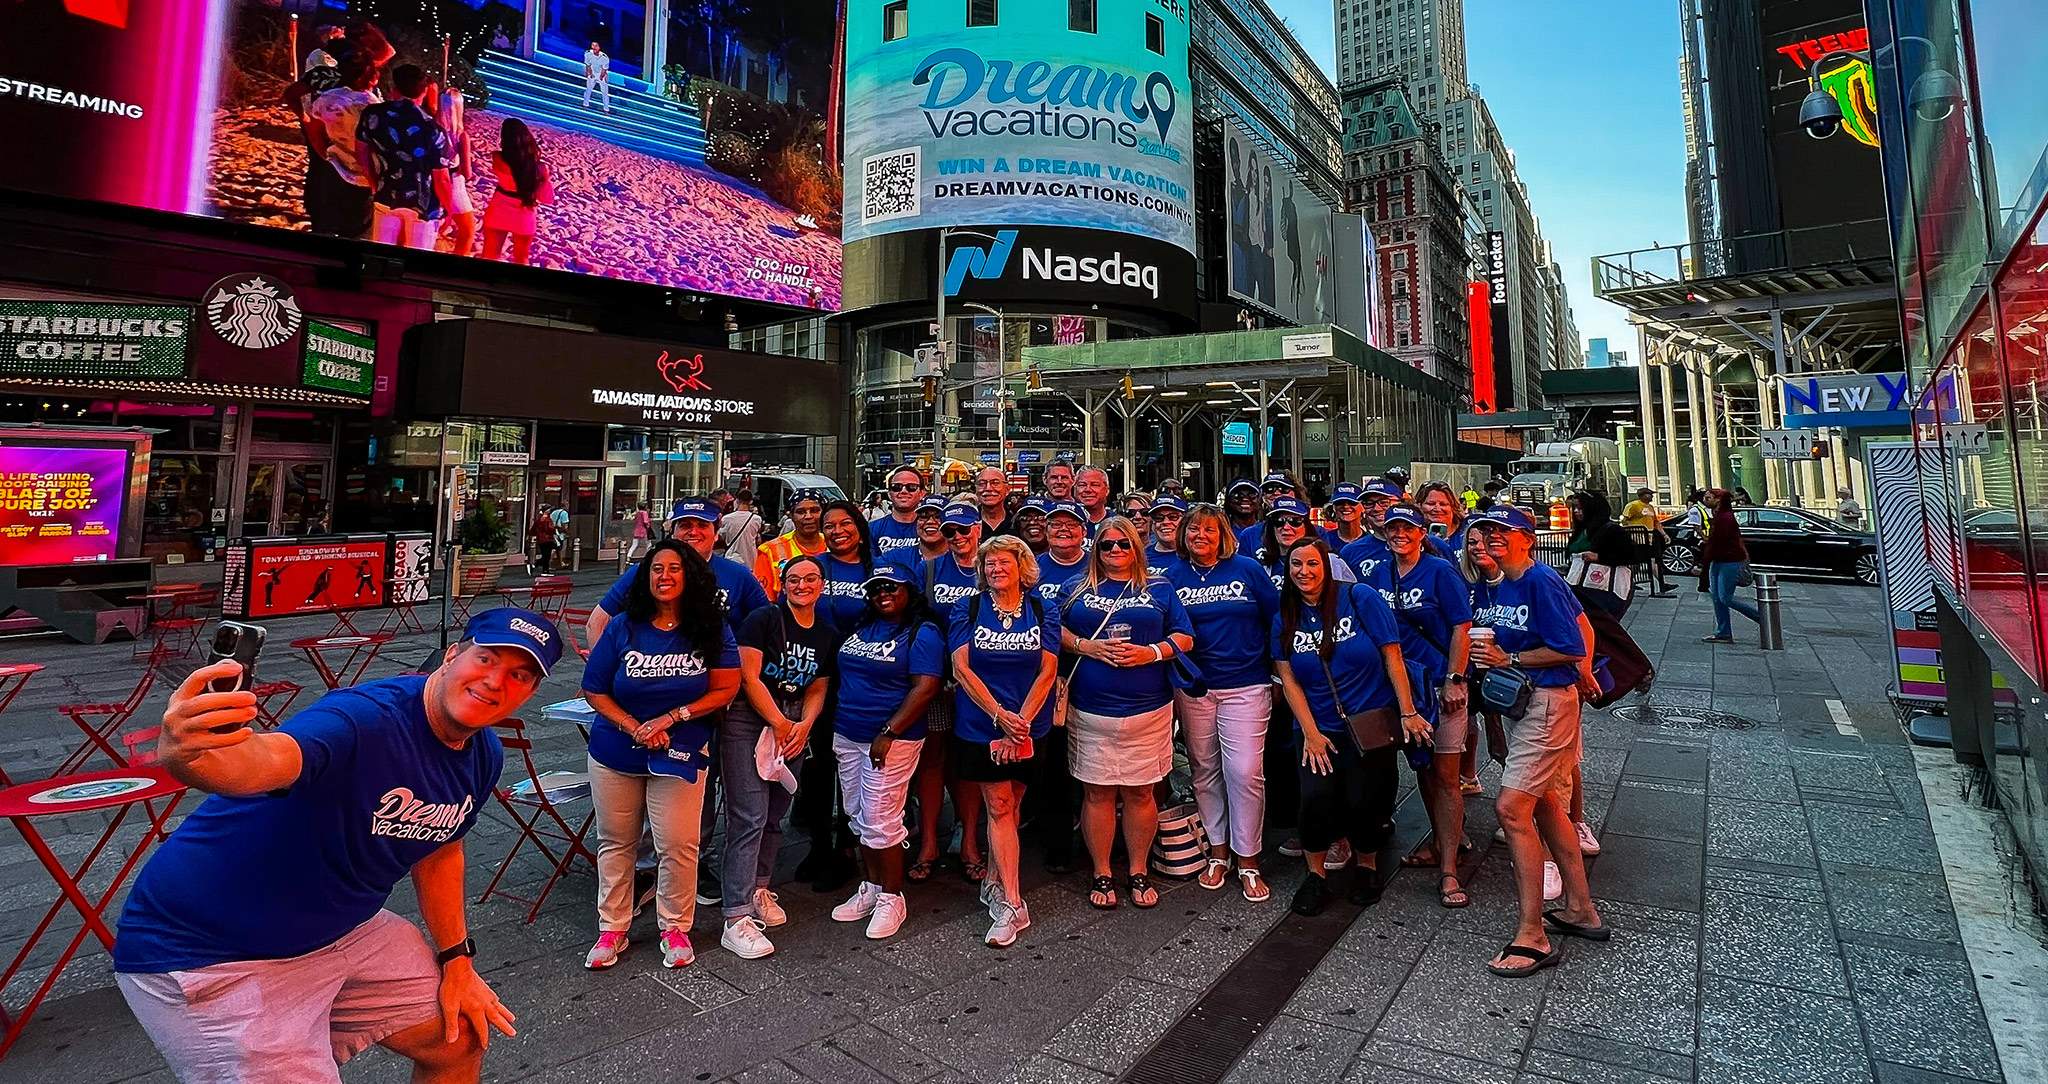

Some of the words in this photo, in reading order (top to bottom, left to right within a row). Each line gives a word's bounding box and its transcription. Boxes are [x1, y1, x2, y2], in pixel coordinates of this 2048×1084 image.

[912, 48, 1148, 124] Dream
[0, 77, 143, 119] STREAMING
[938, 159, 984, 175] WIN
[993, 158, 1010, 173] A
[1018, 159, 1100, 178] DREAM
[934, 181, 1192, 226] DREAMVACATIONS.COM/NYC
[1489, 234, 1504, 275] Locker
[754, 257, 780, 270] TOO
[783, 263, 809, 276] HOT
[1022, 247, 1158, 299] Nasdaq
[747, 268, 763, 280] TO
[765, 272, 815, 289] HANDLE
[1492, 277, 1506, 304] Foot
[16, 340, 143, 362] COFFEE
[307, 333, 375, 365] STARBUCKS
[591, 389, 656, 407] TAMASHII
[643, 409, 672, 421] NEW
[676, 411, 712, 424] YORK
[0, 480, 89, 488] OOF-RAISING
[65, 488, 93, 499] OF
[261, 555, 283, 563] TONY
[1176, 585, 1233, 600] Dream
[974, 625, 1035, 643] Dream
[624, 650, 693, 669] Dream
[373, 786, 465, 829] Dream
